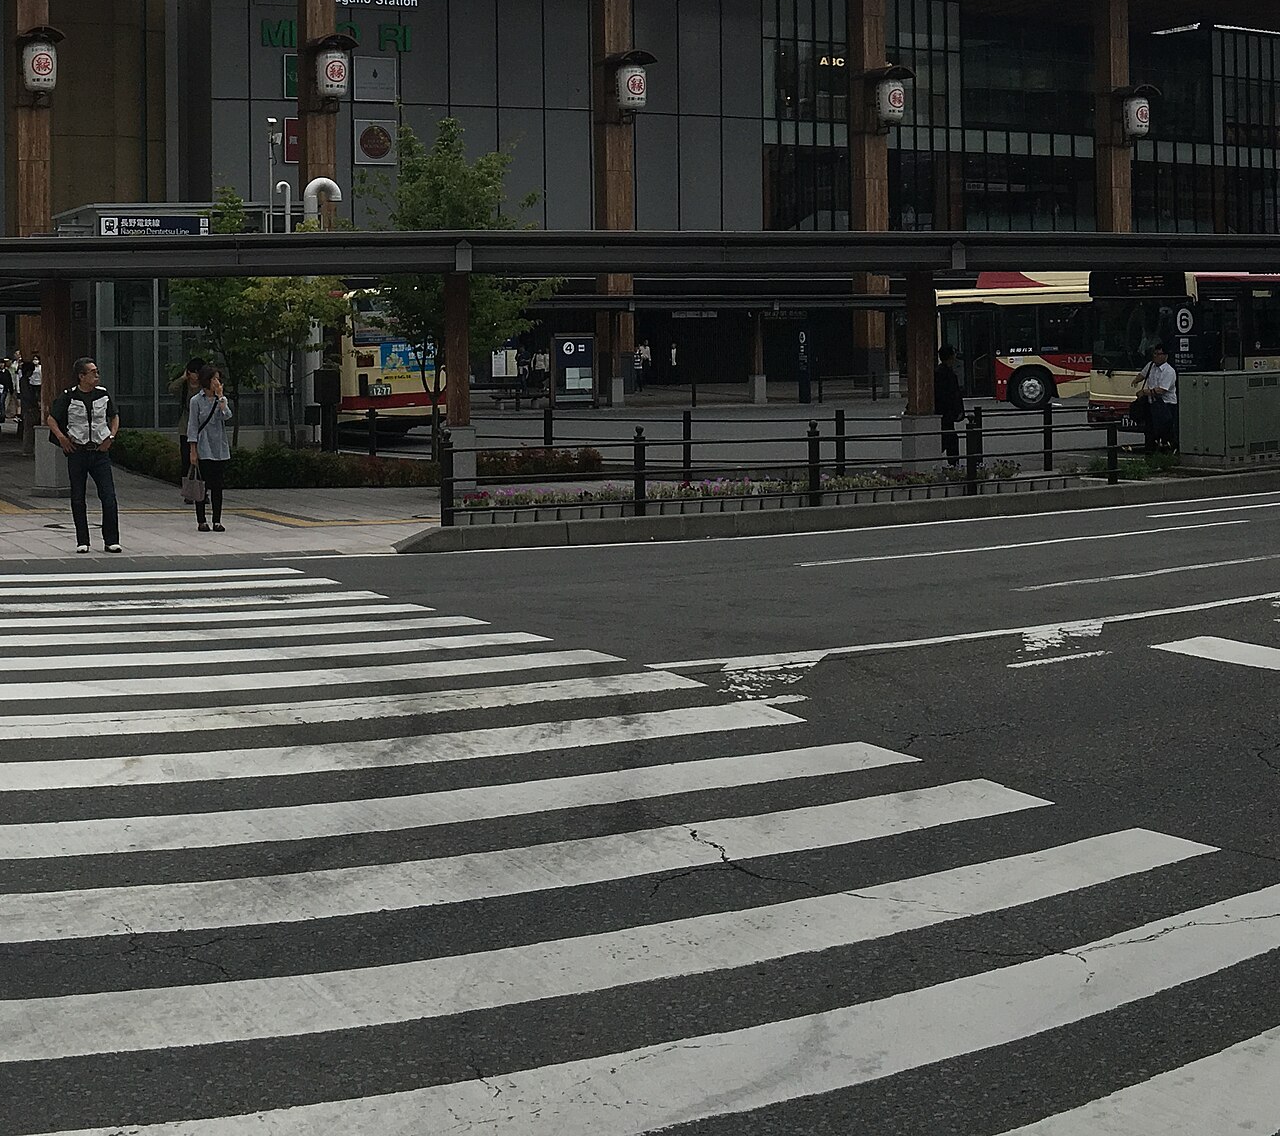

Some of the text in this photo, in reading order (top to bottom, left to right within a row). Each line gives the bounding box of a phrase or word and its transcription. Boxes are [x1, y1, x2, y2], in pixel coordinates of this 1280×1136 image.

[261, 19, 297, 48] MI
[377, 23, 413, 52] RI
[121, 218, 160, 227] 長野電鉄線
[146, 227, 176, 235] Dentetsu
